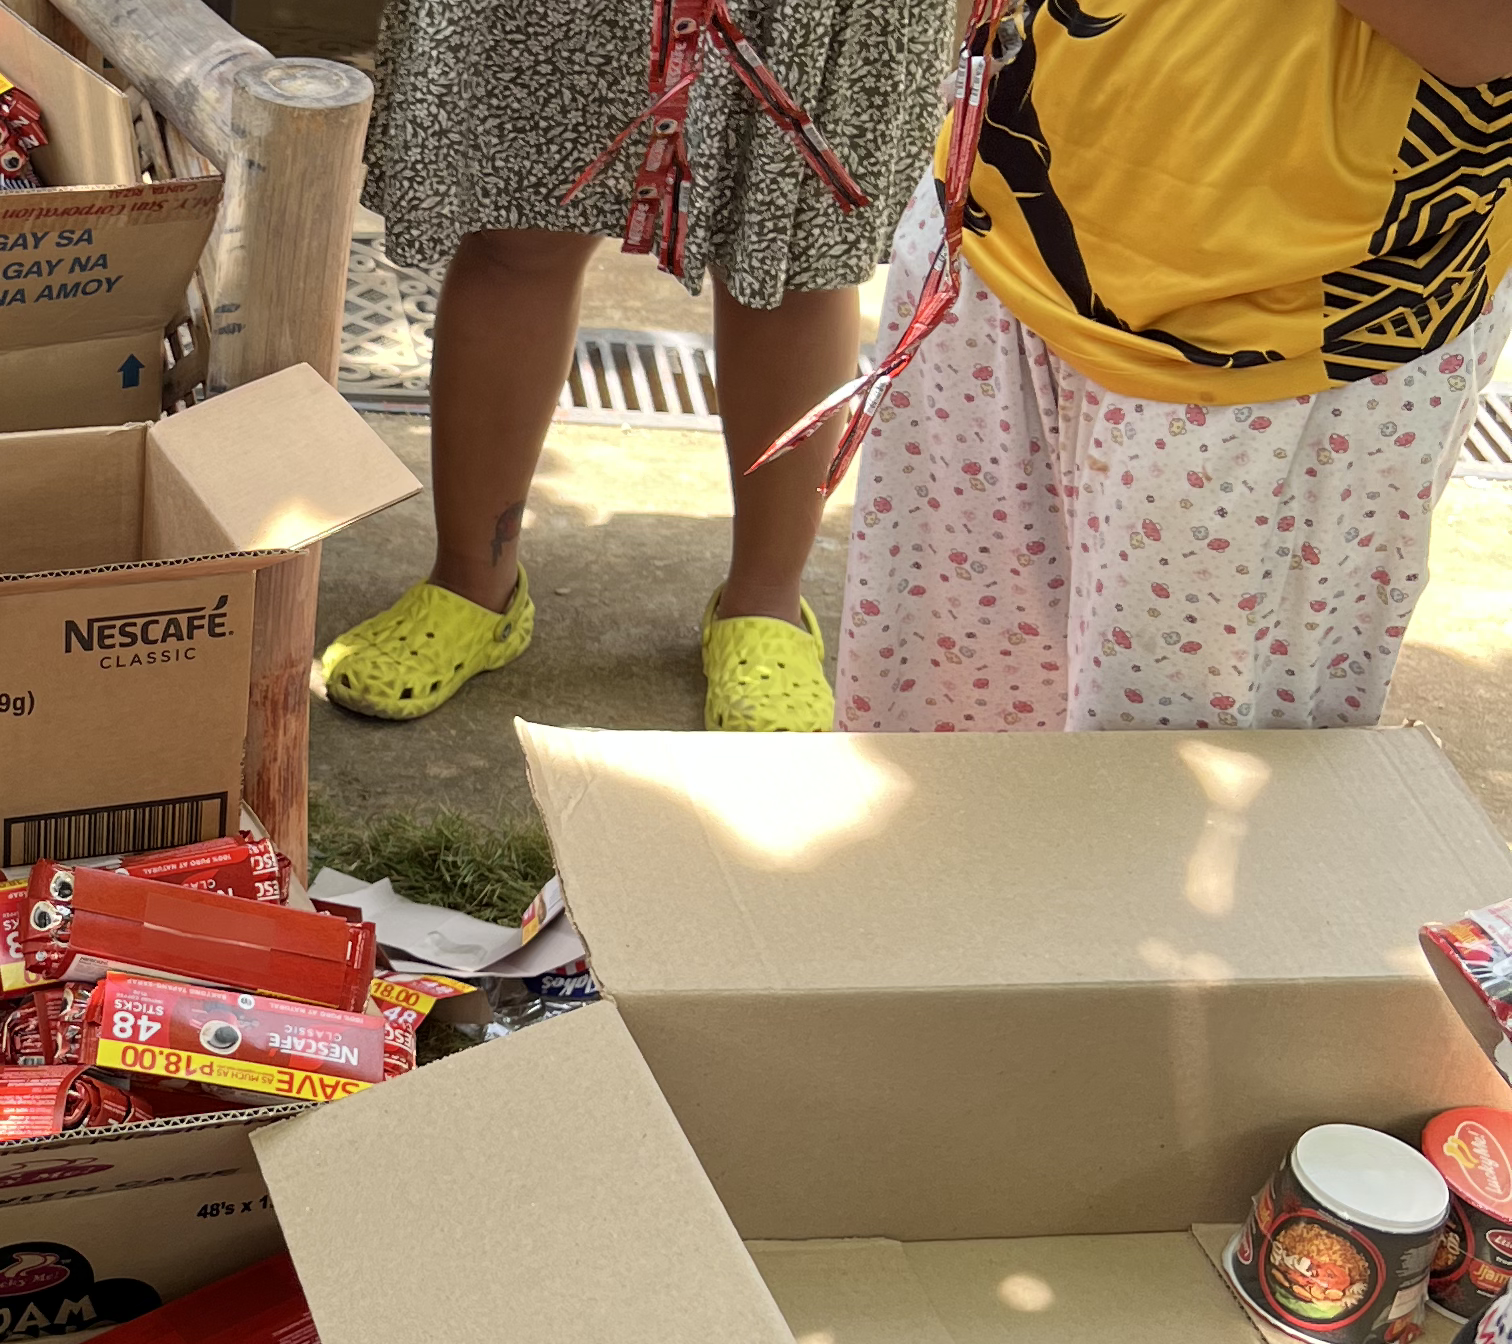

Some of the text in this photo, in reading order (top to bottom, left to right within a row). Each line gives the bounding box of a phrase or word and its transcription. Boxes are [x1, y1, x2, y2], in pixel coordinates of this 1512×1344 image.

[55, 227, 94, 246] SA
[69, 253, 109, 274] NA
[33, 274, 124, 303] AMOY
[98, 646, 198, 670] CLASSIC
[114, 998, 165, 1017] STICKS
[112, 1010, 162, 1042] 48
[284, 1024, 343, 1043] CLASSIC
[230, 1071, 260, 1084] MUCH
[275, 1069, 361, 1101] SAVE
[197, 1201, 235, 1219] 48's
[240, 1201, 254, 1214] x
